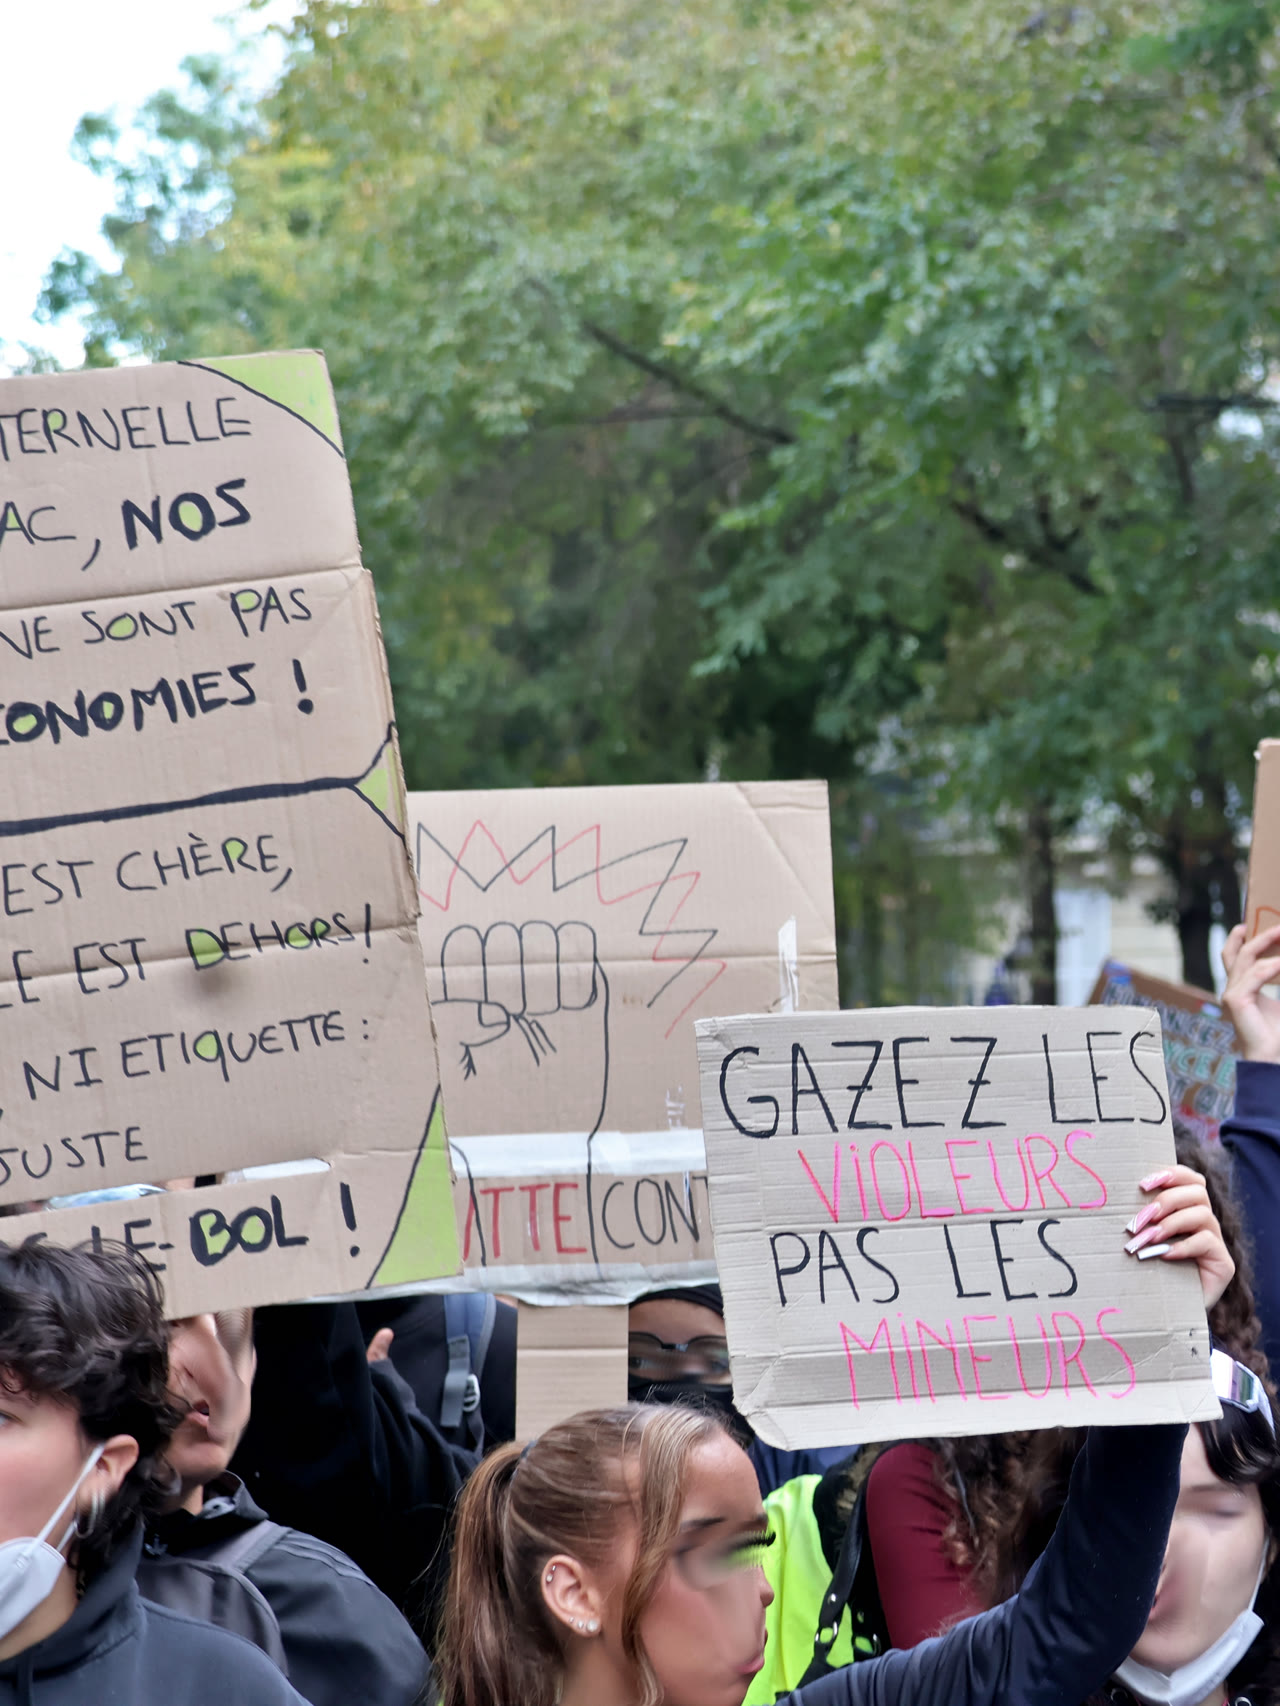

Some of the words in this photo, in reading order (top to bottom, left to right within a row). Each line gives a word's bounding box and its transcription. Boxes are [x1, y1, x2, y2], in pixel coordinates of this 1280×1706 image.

[121, 478, 251, 550] NOS
[82, 601, 196, 644] SONT
[229, 586, 312, 637] PAS
[1, 860, 94, 916] EST
[117, 832, 292, 893] CHÈRE,
[74, 939, 147, 995] EST
[23, 1047, 103, 1100] NI
[719, 1036, 1008, 1139] GAZEZ
[1041, 1030, 1168, 1125] LES
[769, 1226, 900, 1308] PAS
[942, 1217, 1079, 1302] LES
